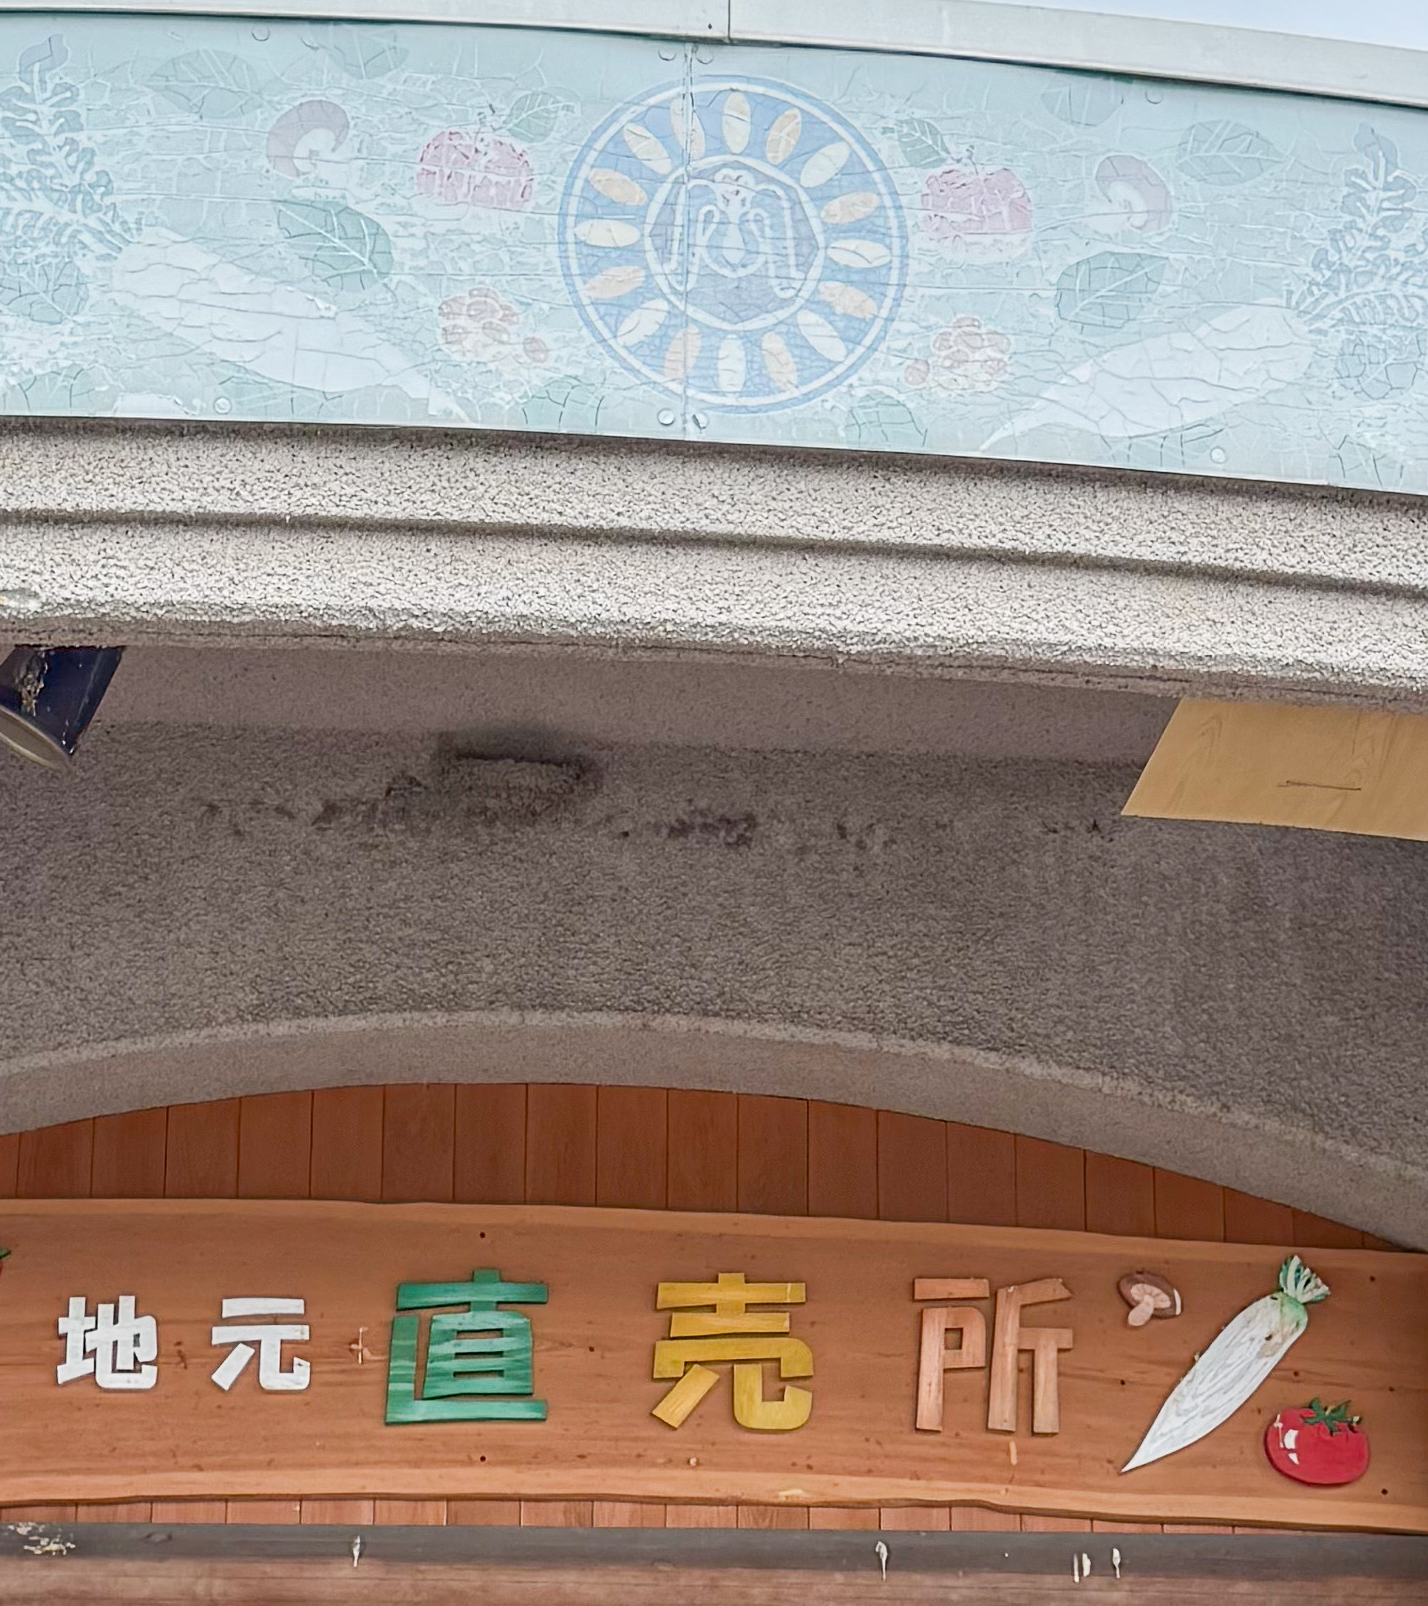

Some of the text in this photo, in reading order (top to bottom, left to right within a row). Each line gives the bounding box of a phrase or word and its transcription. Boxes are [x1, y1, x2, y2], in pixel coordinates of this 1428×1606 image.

[57, 1269, 1073, 1434] 地元直売所
